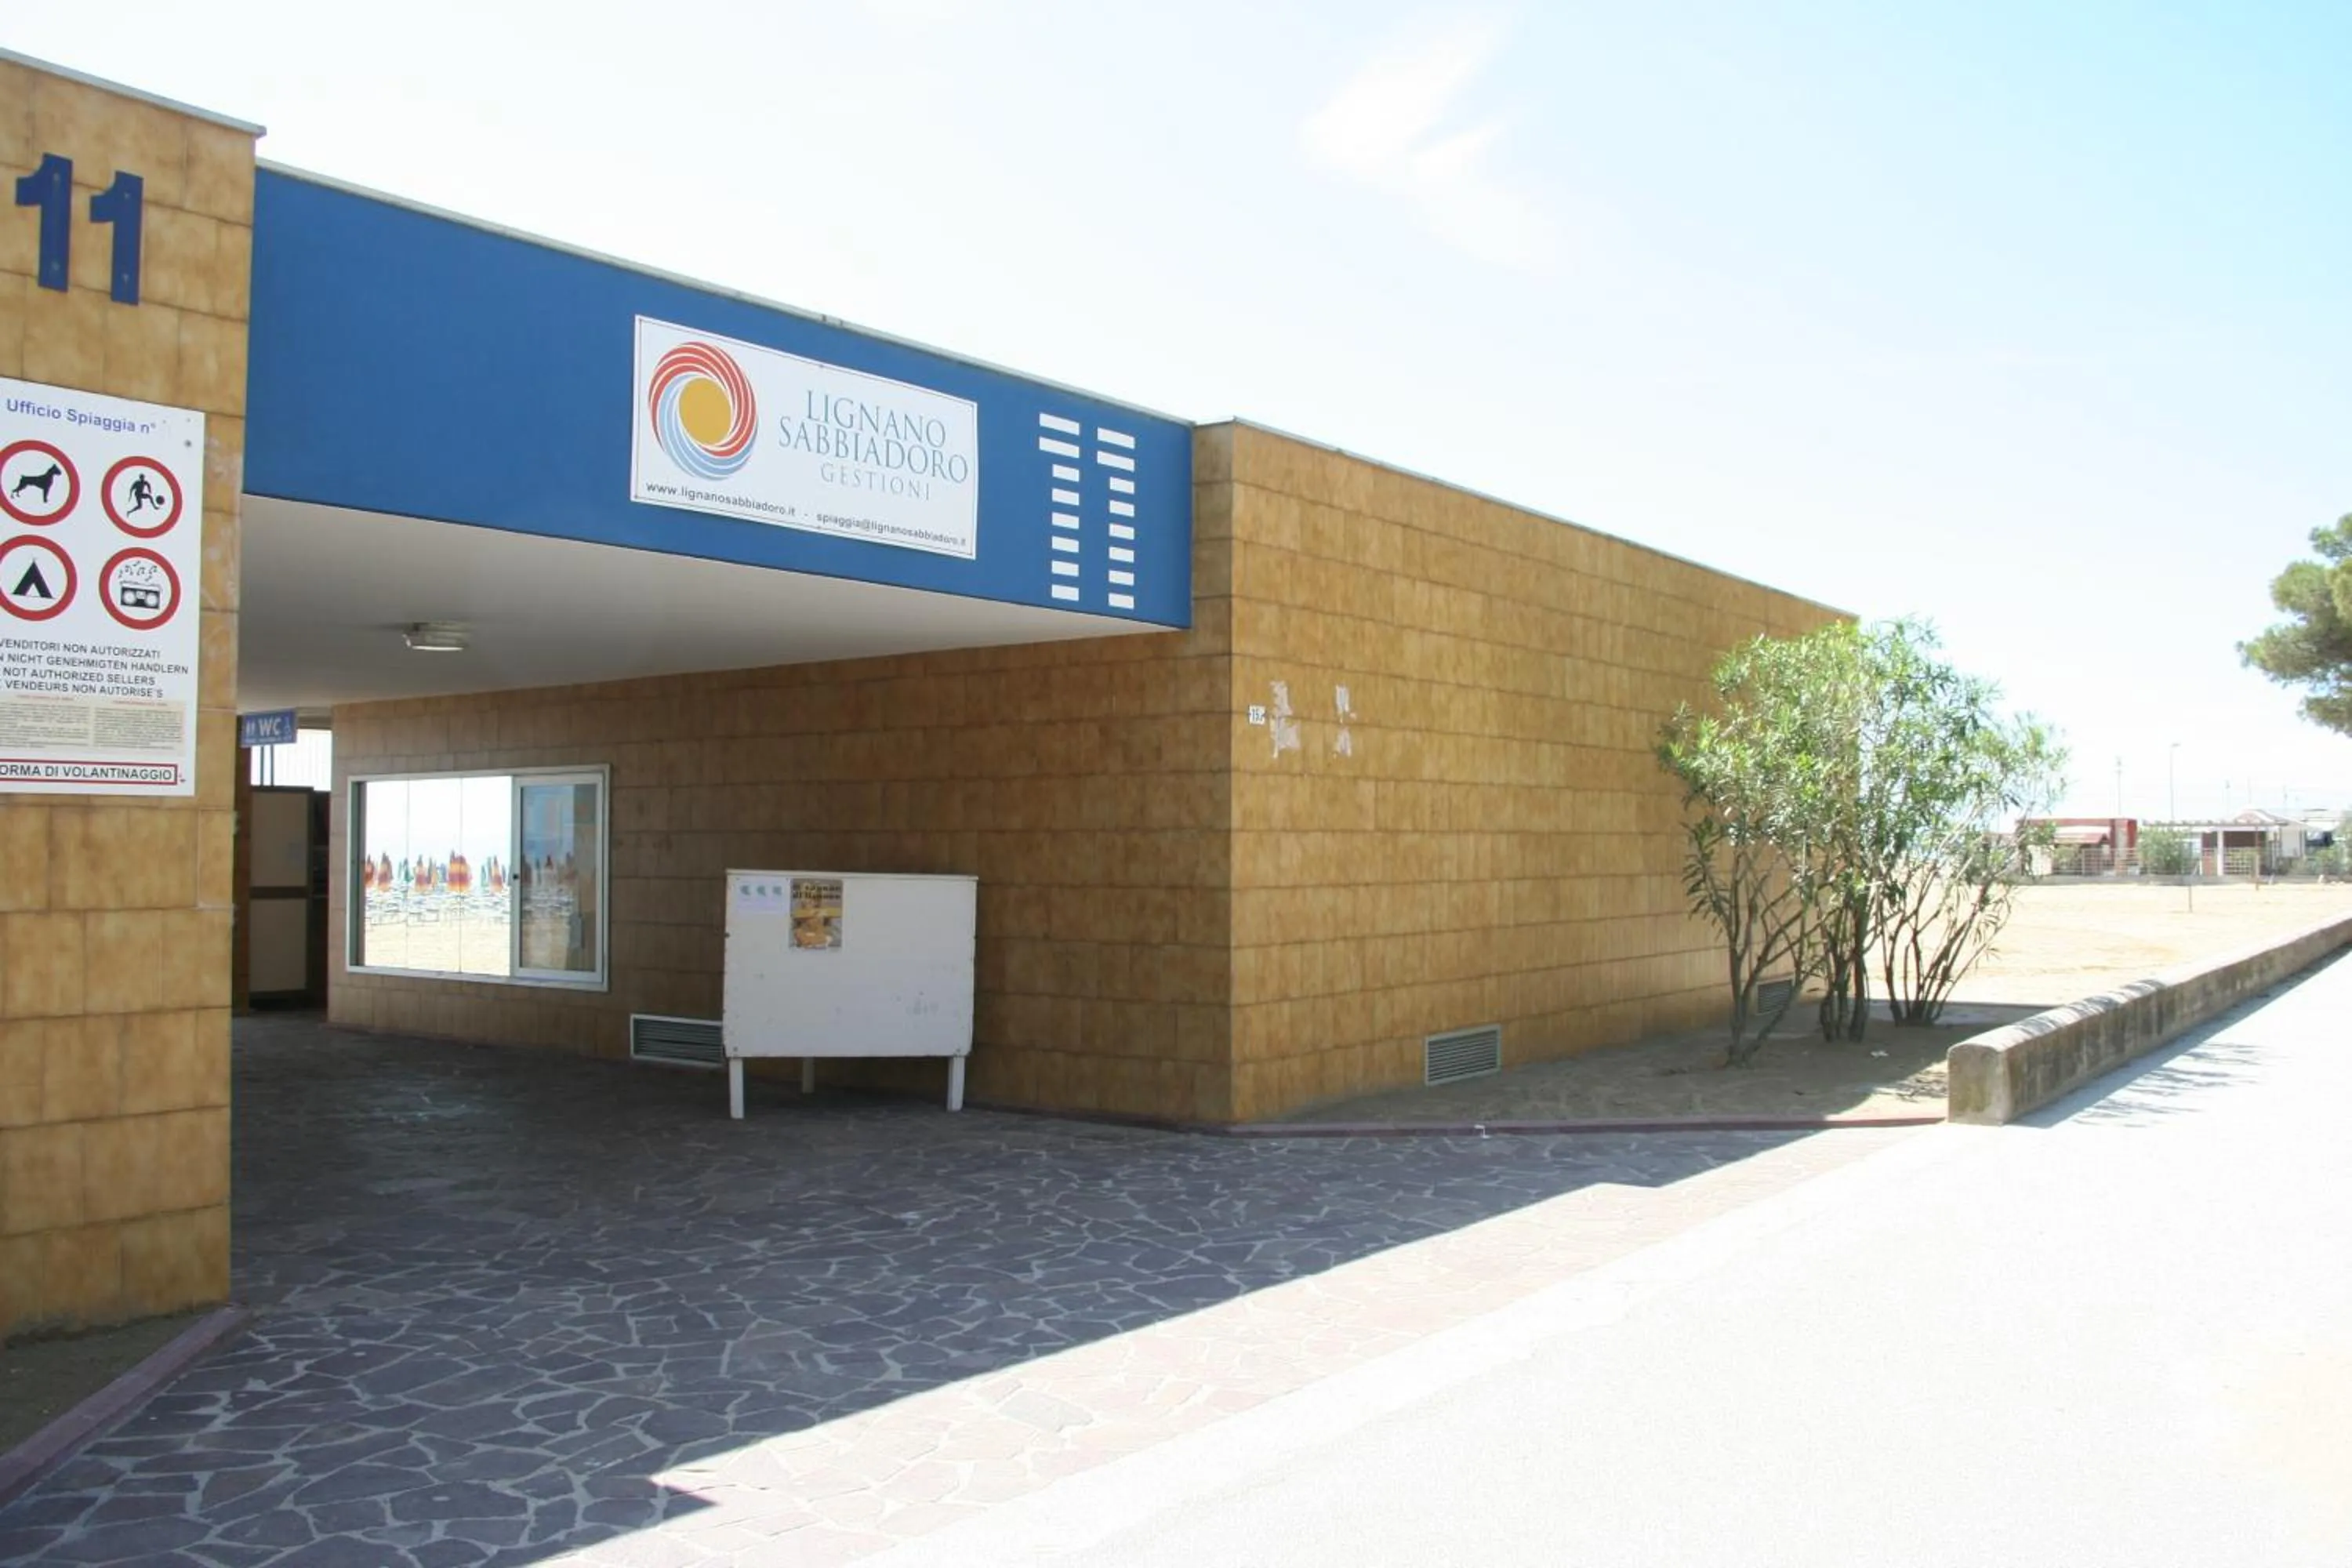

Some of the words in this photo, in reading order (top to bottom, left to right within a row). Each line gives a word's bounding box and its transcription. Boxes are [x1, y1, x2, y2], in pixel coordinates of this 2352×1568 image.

[16, 152, 144, 306] 11
[6, 397, 62, 419] Ufficio
[67, 408, 136, 432] Spiaggia
[807, 390, 946, 448] LIGNANO
[779, 416, 968, 483] SABBIADORO
[821, 463, 930, 501] GESTIONI
[646, 482, 796, 517] www.lignanosabbiadoro.it
[816, 513, 967, 546] spiaggia@lignanosabbiadoro.it
[7, 653, 42, 665] NICHT
[46, 655, 128, 670] GENEHMIGTEN
[63, 643, 87, 654] NON
[90, 644, 161, 659] AUTORIZZATI
[2, 666, 27, 677] NOT
[31, 669, 104, 683] AUTHORIZED
[107, 673, 155, 686] SELLERS
[5, 680, 69, 692] VENDEURS
[72, 684, 97, 695] NON
[258, 717, 281, 736] WC
[45, 766, 59, 777] DI
[63, 766, 172, 780] VOLANTINAGGIO
